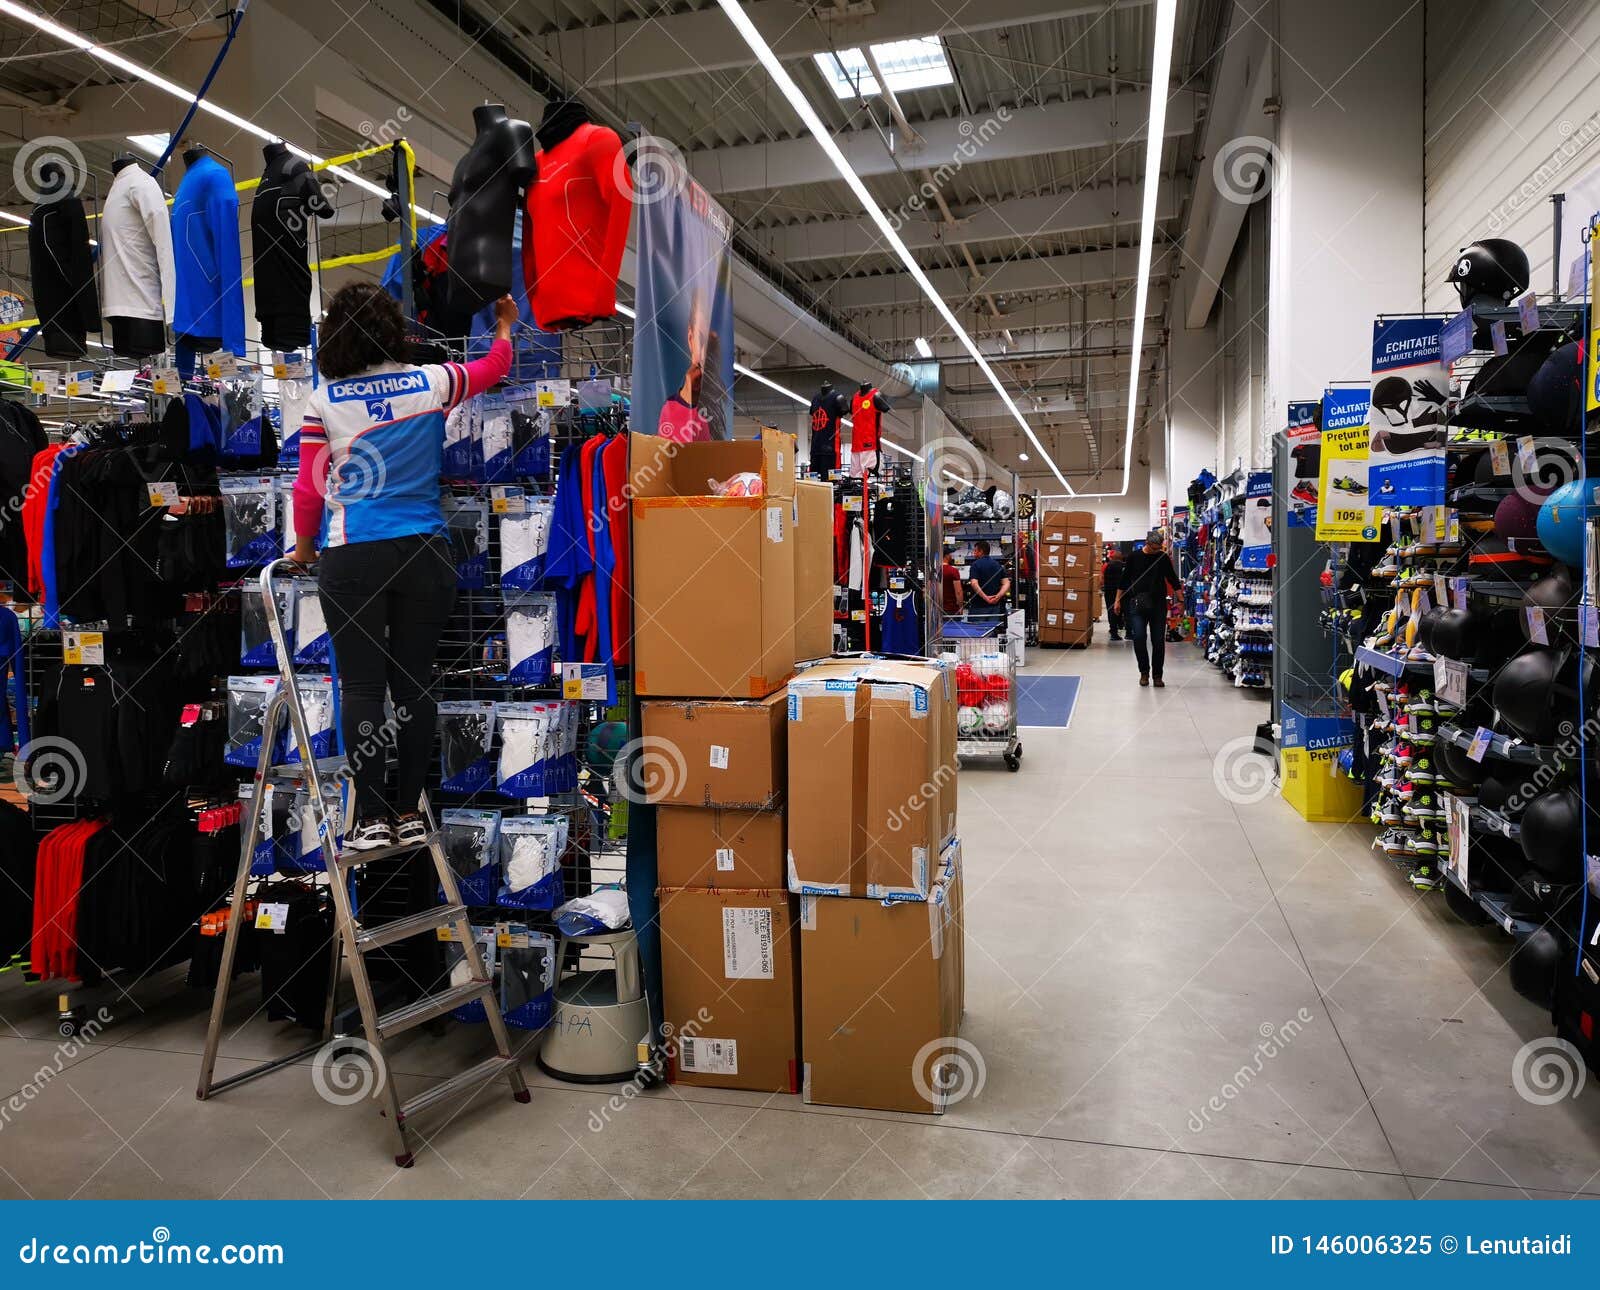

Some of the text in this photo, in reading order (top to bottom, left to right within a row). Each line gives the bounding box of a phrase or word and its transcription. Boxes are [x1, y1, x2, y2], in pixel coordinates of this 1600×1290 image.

[1390, 352, 1413, 361] MULTE
[333, 374, 424, 398] DECATHLON
[1339, 442, 1354, 452] tot
[1337, 511, 1355, 521] 109
